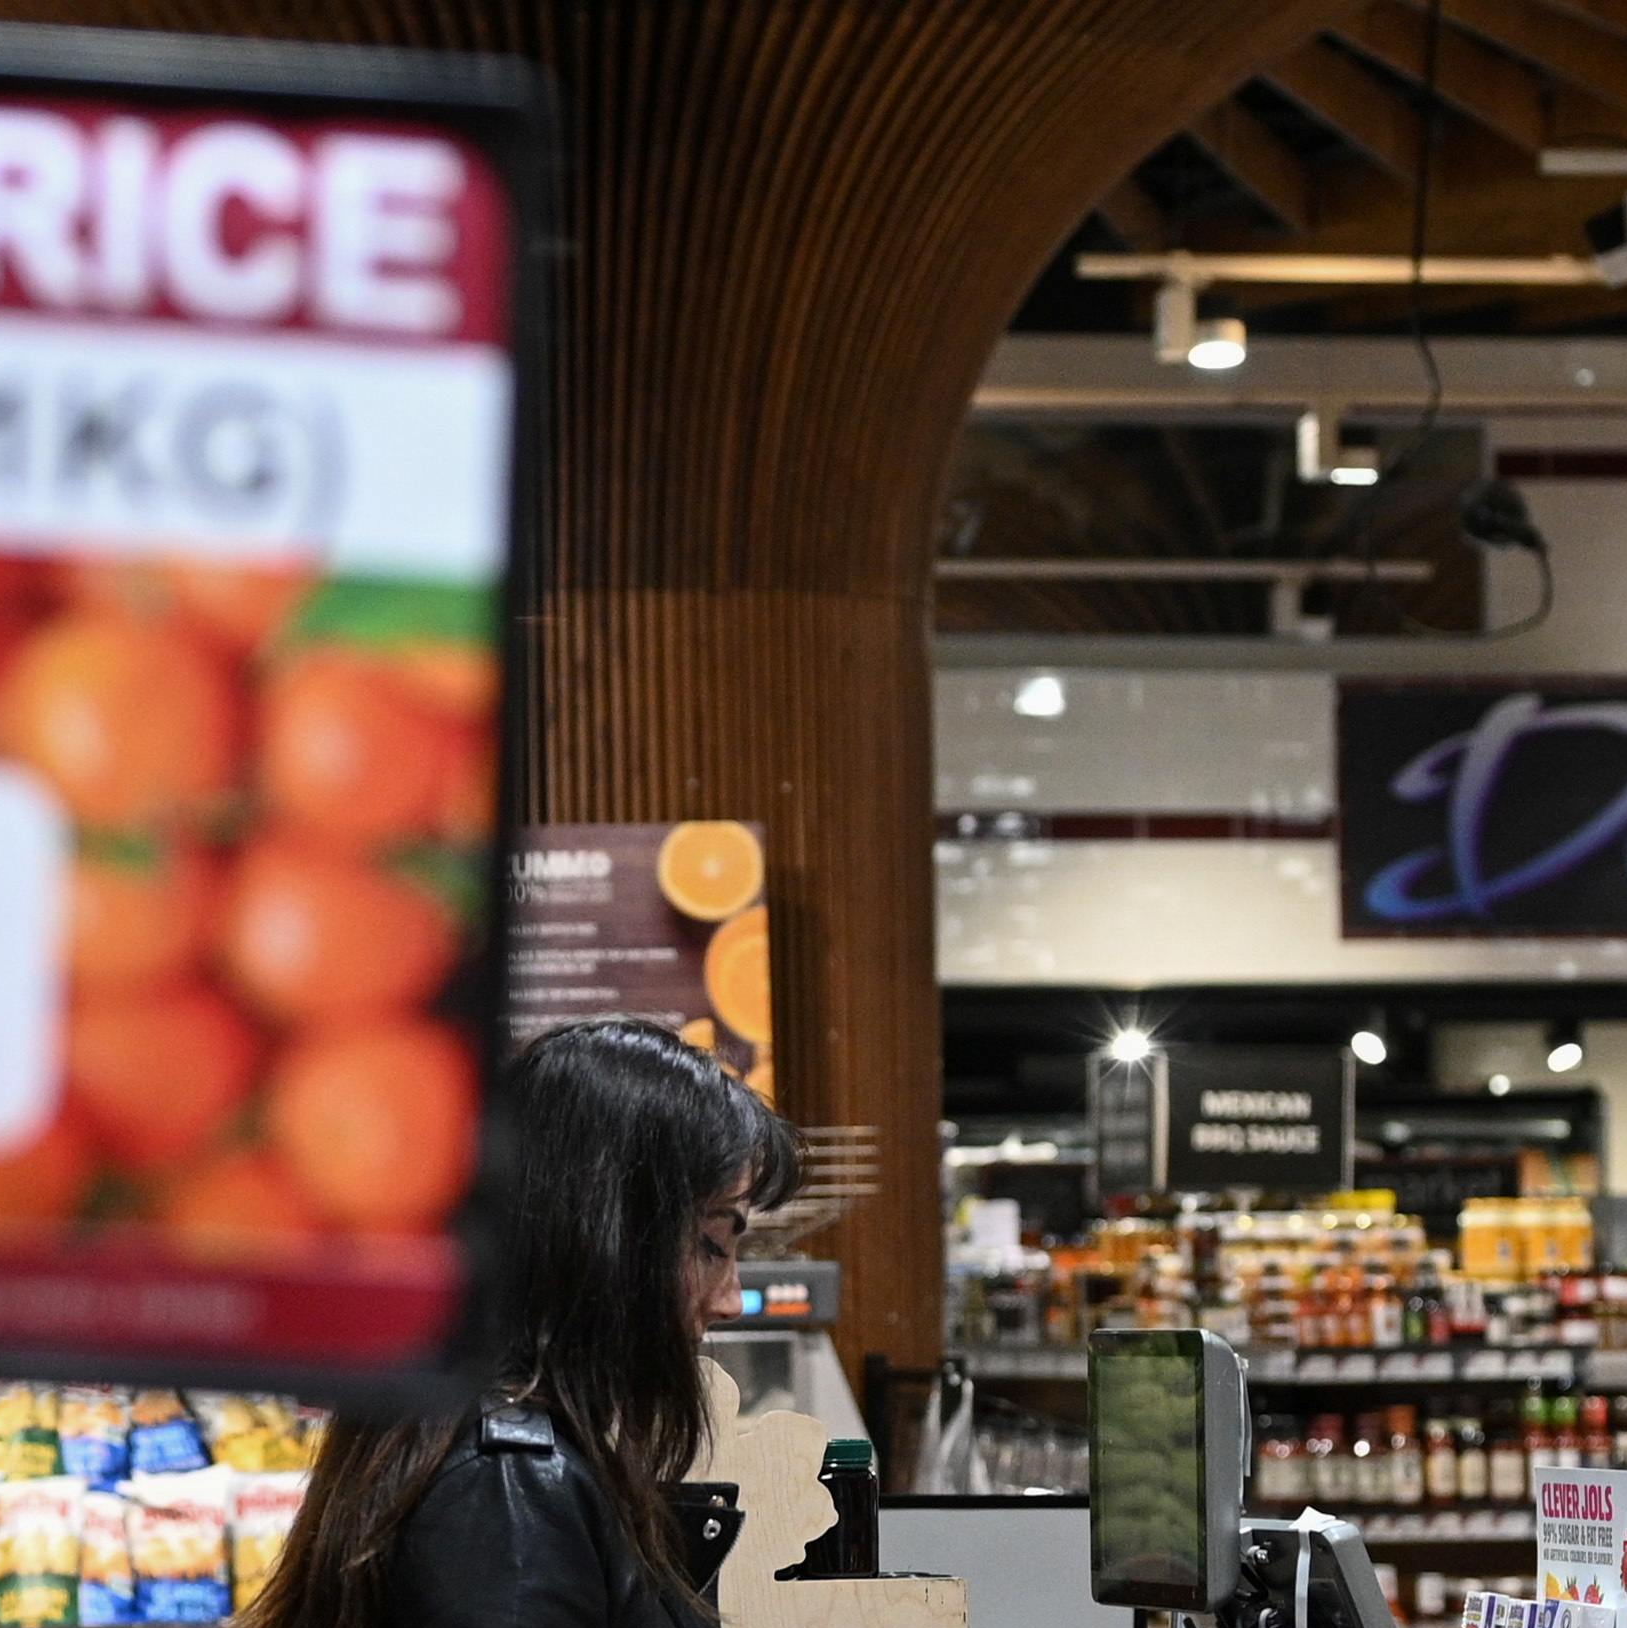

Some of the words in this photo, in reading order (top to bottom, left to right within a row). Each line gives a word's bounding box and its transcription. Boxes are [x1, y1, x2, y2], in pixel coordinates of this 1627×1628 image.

[1542, 1482, 1580, 1519] CLEVER
[1581, 1484, 1613, 1522] JOLS
[1543, 1522, 1557, 1544] 99%
[1558, 1524, 1580, 1546] SUGAR
[1581, 1526, 1586, 1546] &
[1587, 1525, 1597, 1548] FAT
[1598, 1526, 1613, 1549] FREE
